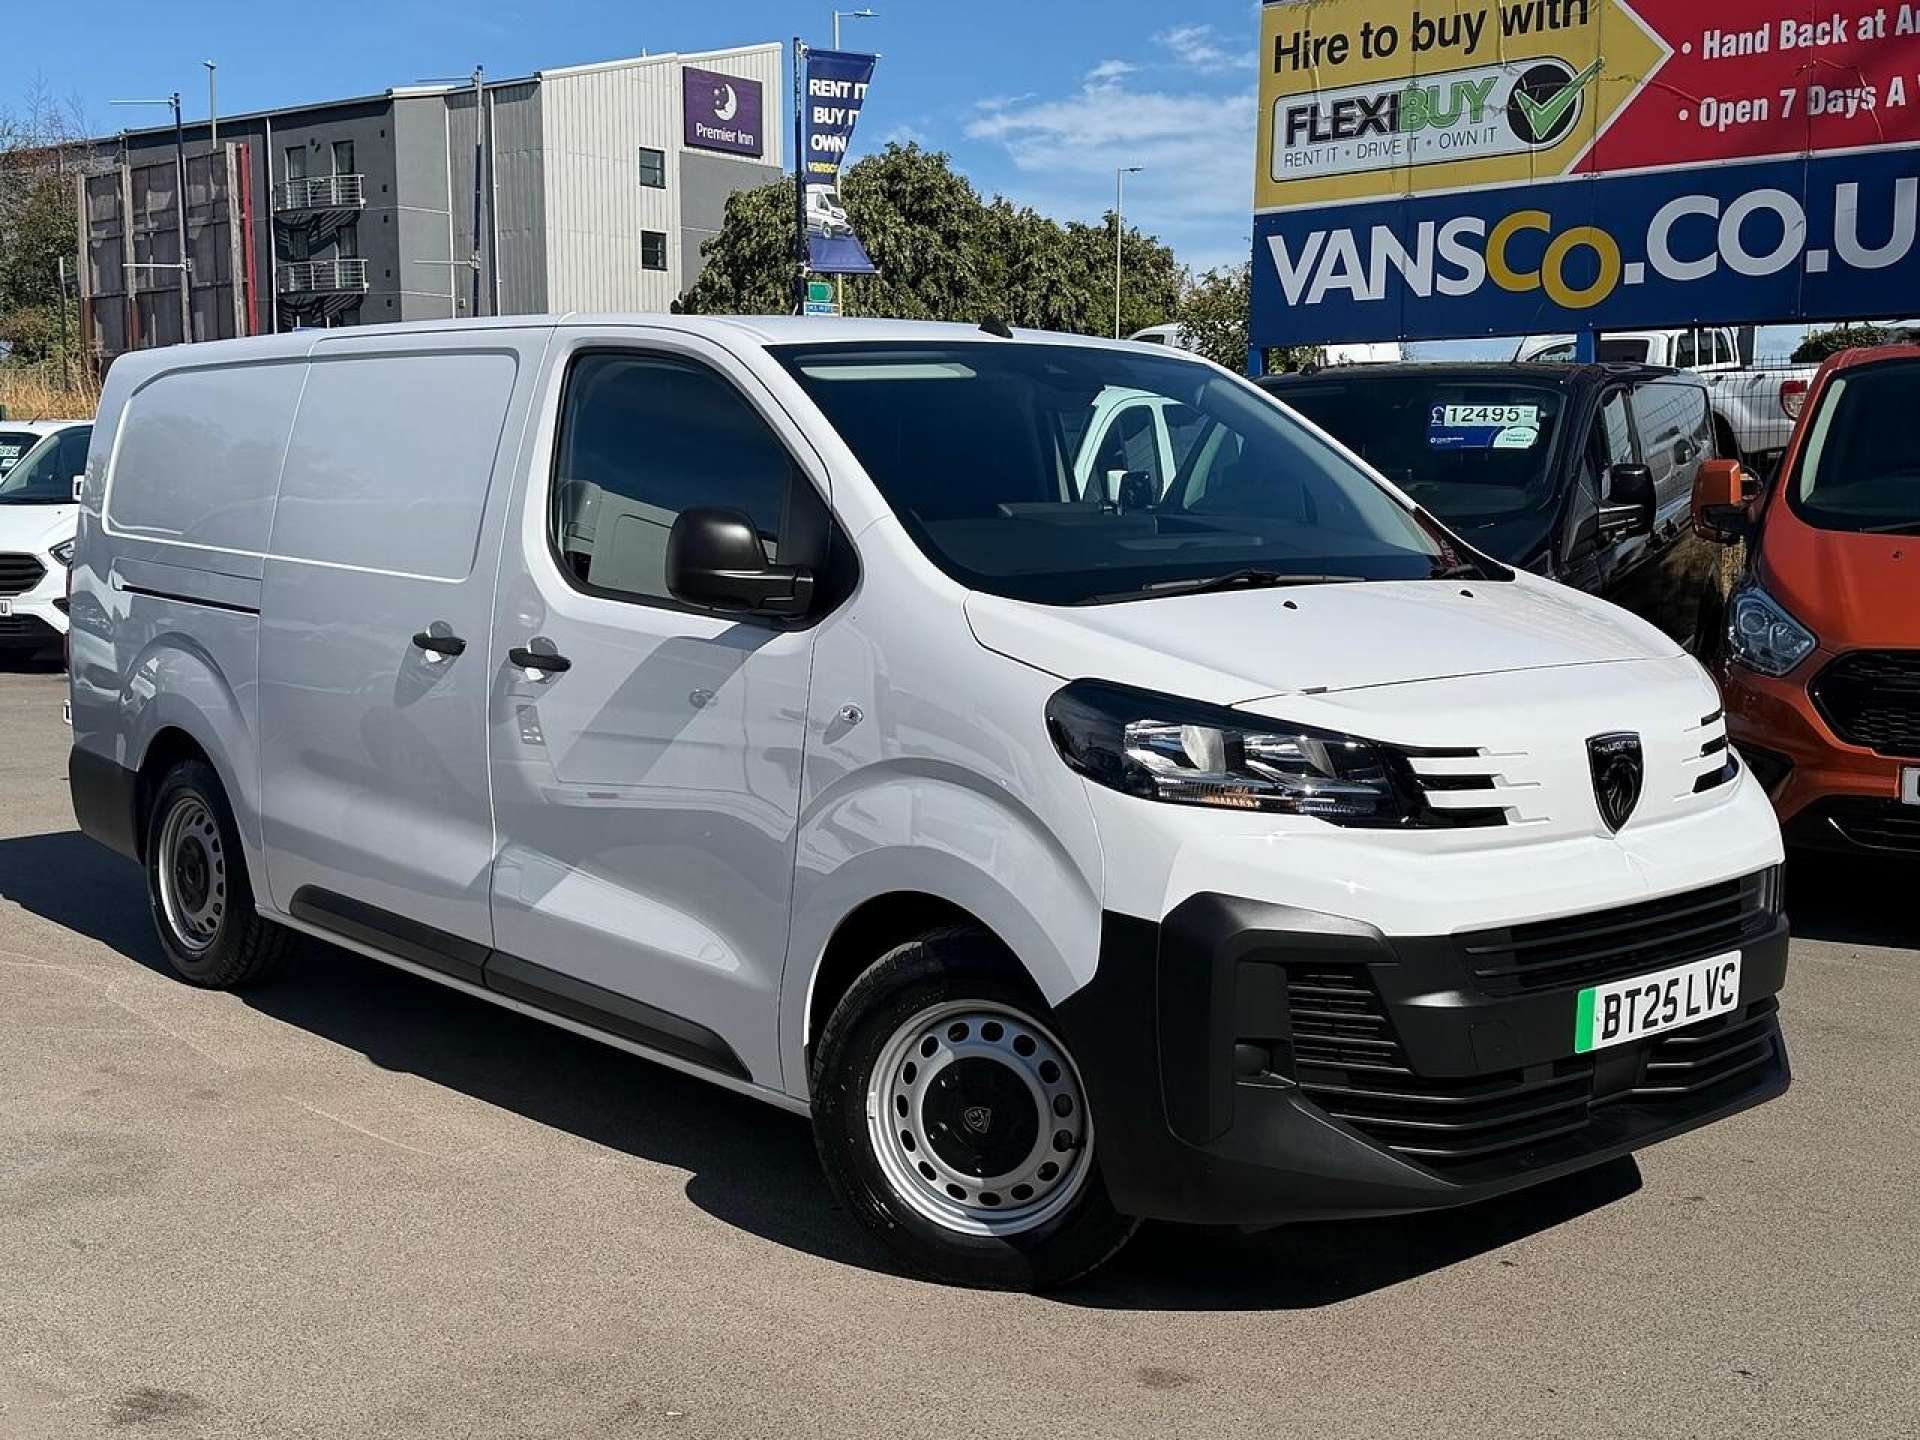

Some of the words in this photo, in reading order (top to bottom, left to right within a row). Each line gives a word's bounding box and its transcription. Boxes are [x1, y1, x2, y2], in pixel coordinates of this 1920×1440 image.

[1274, 30, 1349, 73] Hire
[1360, 22, 1399, 59] to
[1412, 10, 1488, 54] buy
[1499, 0, 1588, 37] with
[1703, 23, 1770, 60] Hand
[1780, 13, 1849, 50] Back
[1857, 8, 1886, 40] at
[809, 79, 852, 98] RENT
[854, 83, 869, 100] IT
[1284, 76, 1499, 148] FLEXIBUY
[1700, 97, 1768, 132] Open
[1779, 88, 1796, 118] 7
[1808, 85, 1877, 119] Days
[1886, 76, 1906, 107] A
[696, 123, 736, 142] Premier
[738, 129, 754, 146] Inn
[813, 106, 845, 125] BUY
[811, 134, 847, 152] OWN
[1284, 150, 1321, 168] RENT
[1323, 147, 1339, 163] IT
[1357, 140, 1401, 160] DRIVE
[1403, 137, 1418, 153] IT
[1439, 130, 1477, 149] OWN
[1480, 127, 1497, 143] IT
[1602, 978, 1680, 1040] BT25
[1686, 962, 1736, 1017] LVC
